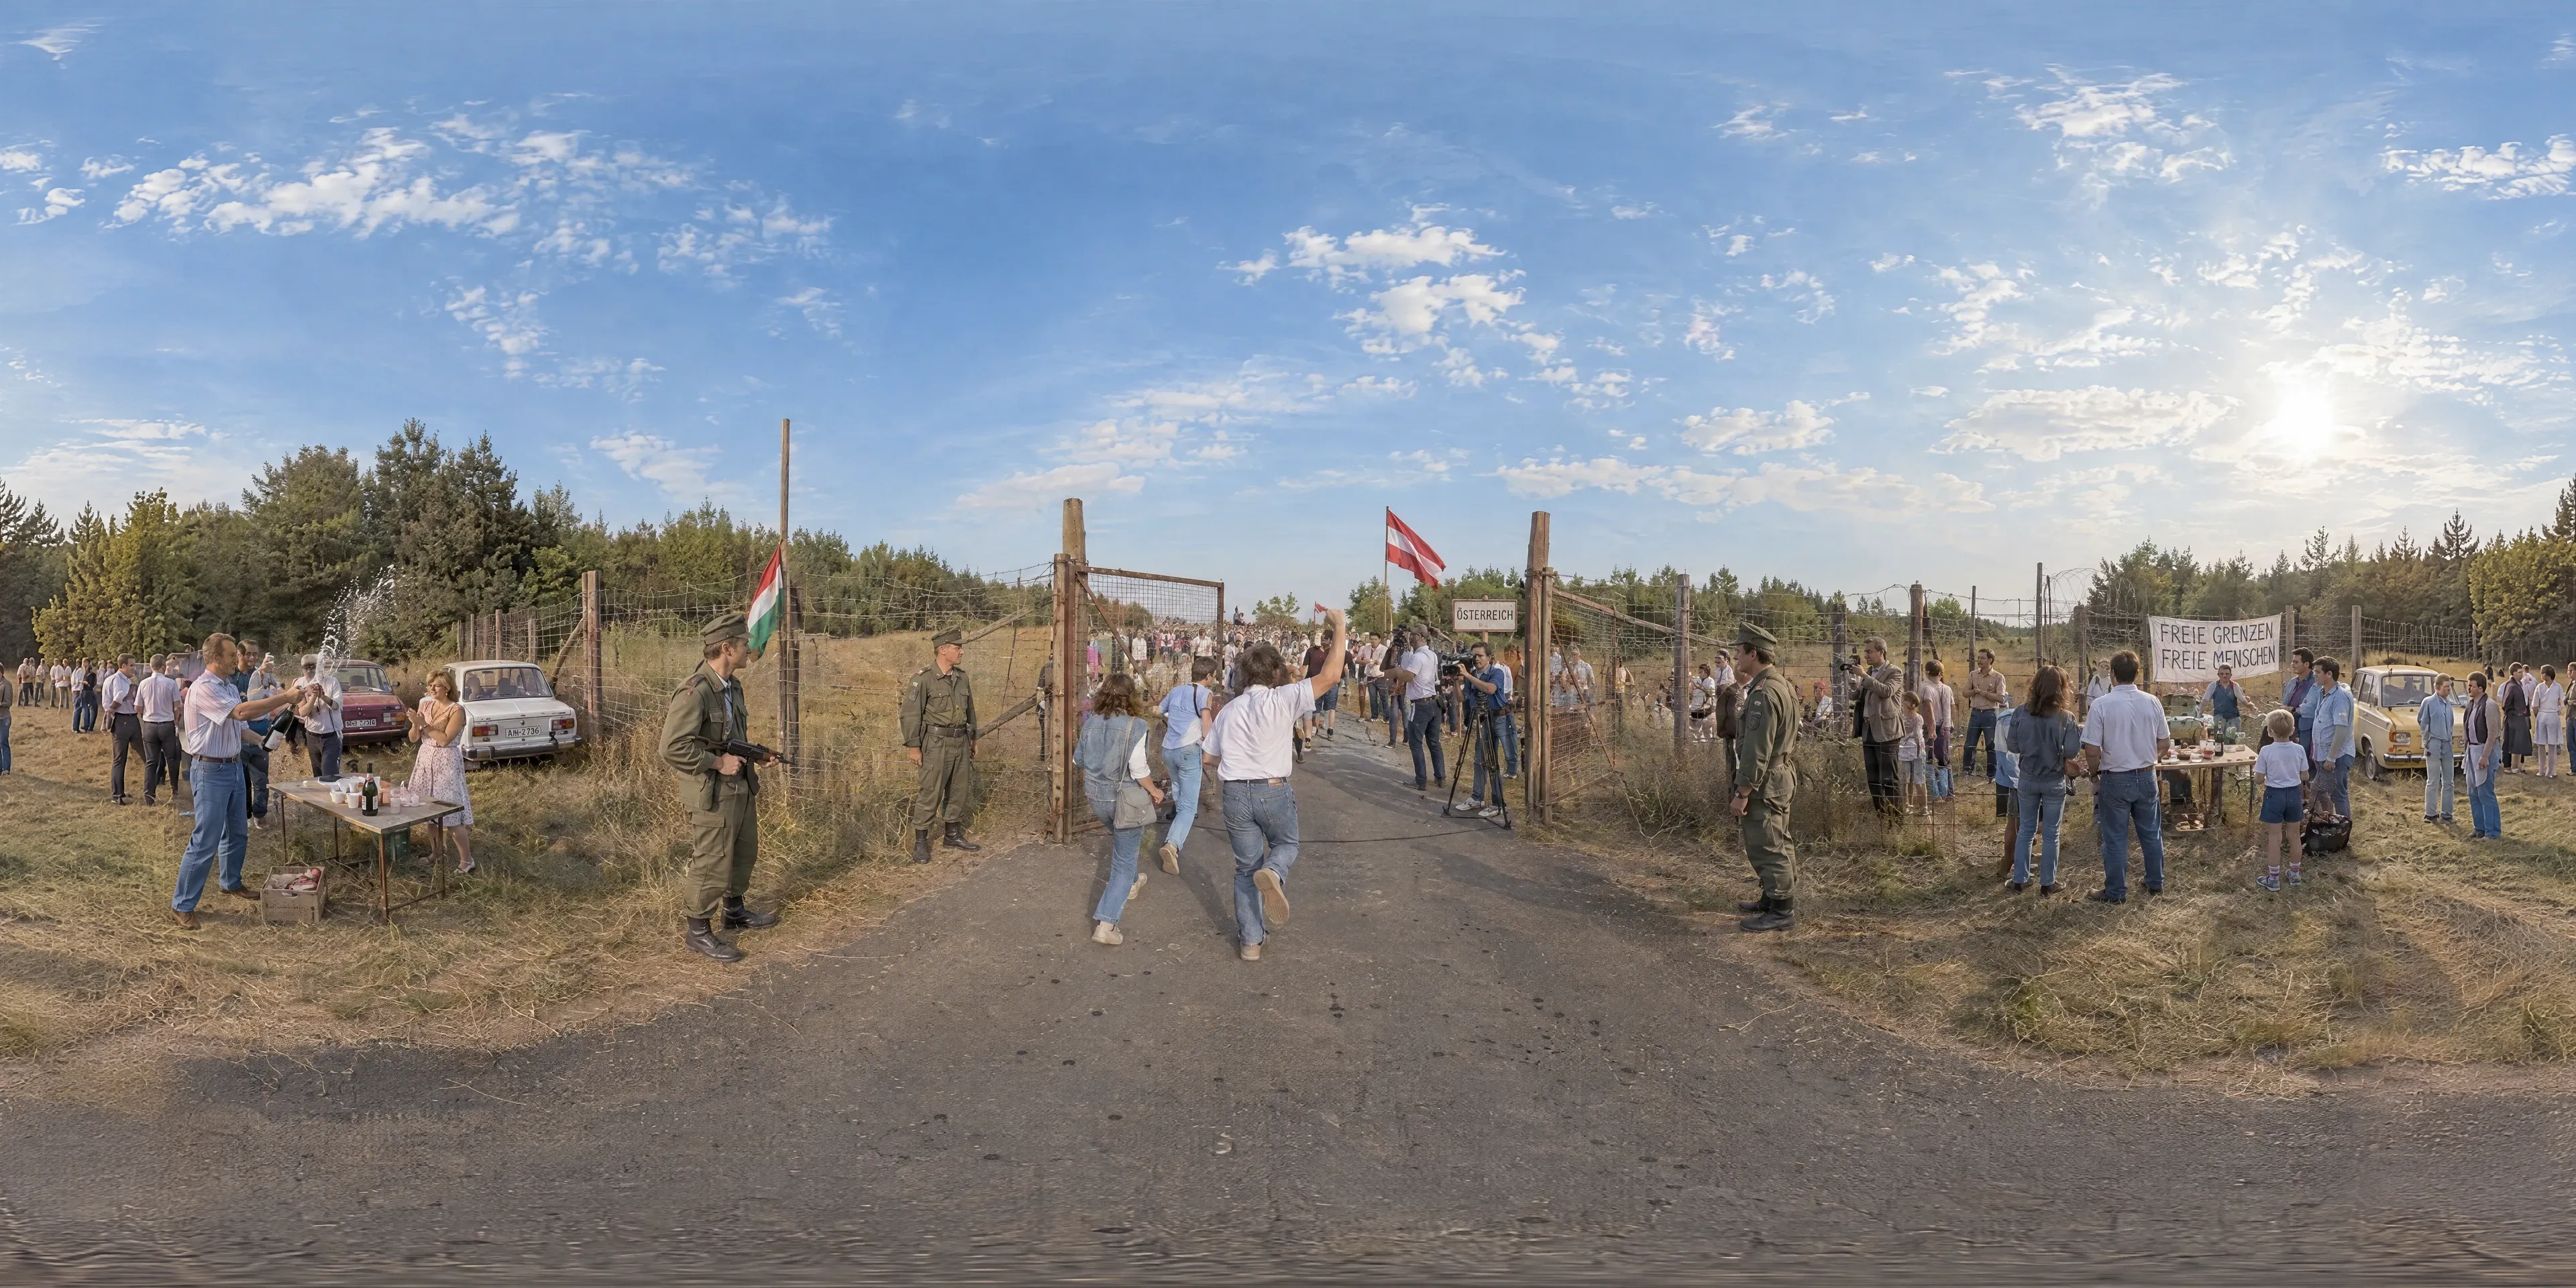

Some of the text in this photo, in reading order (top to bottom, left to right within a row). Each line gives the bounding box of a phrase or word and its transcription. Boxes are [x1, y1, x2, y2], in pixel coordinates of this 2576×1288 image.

[1456, 606, 1513, 621] ÖSTERREICH
[2160, 621, 2273, 645] FREIE GRENZEN
[2162, 645, 2275, 670] FREIE MENSCHEN
